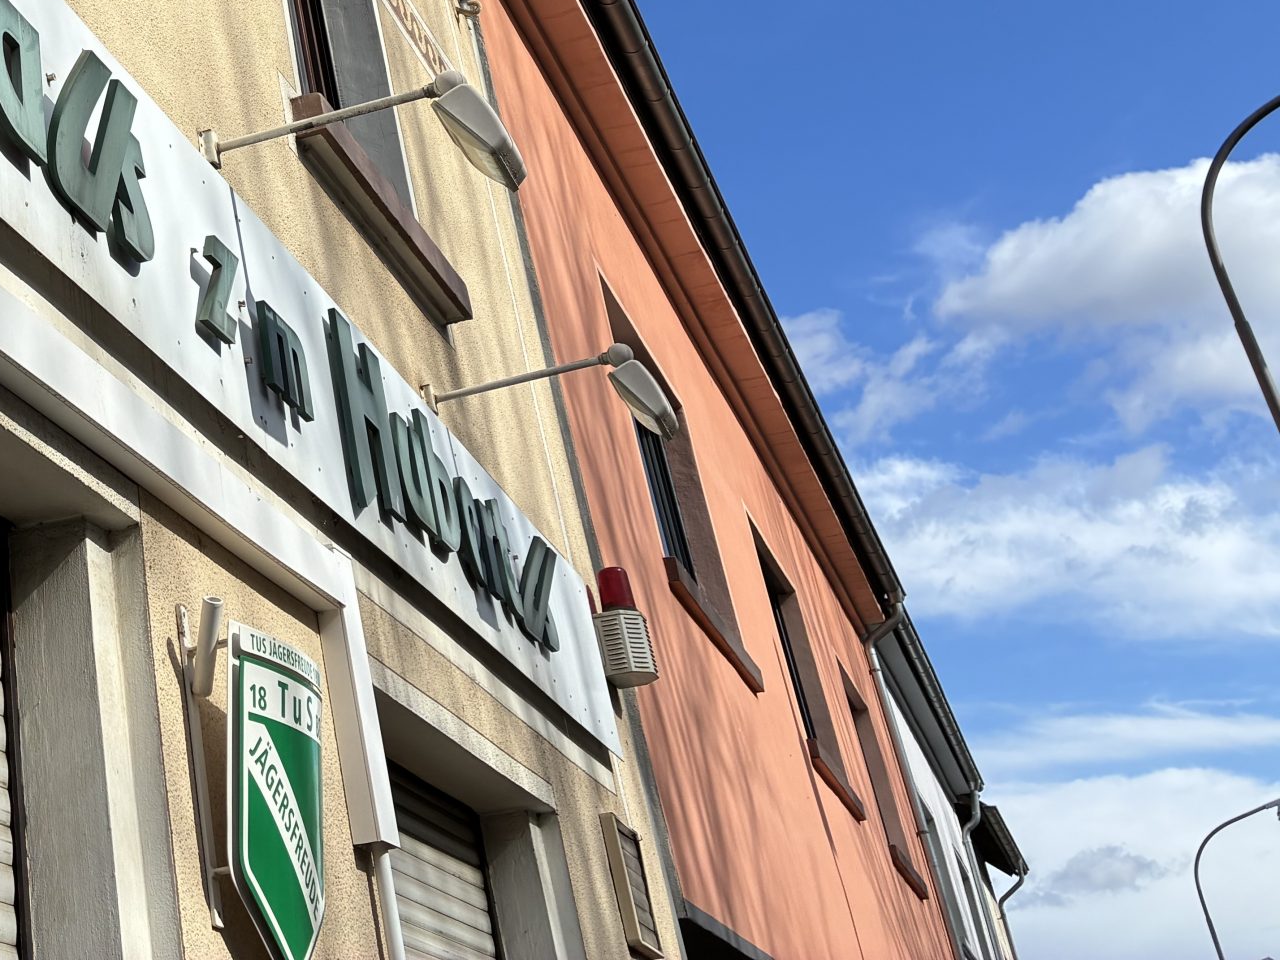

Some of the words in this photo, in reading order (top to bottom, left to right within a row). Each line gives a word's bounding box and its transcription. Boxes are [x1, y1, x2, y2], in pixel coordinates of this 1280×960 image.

[250, 633, 267, 655] TUS
[249, 683, 268, 712] 18
[277, 680, 314, 733] TuS
[248, 736, 321, 922] JÄGERSFREUDE
